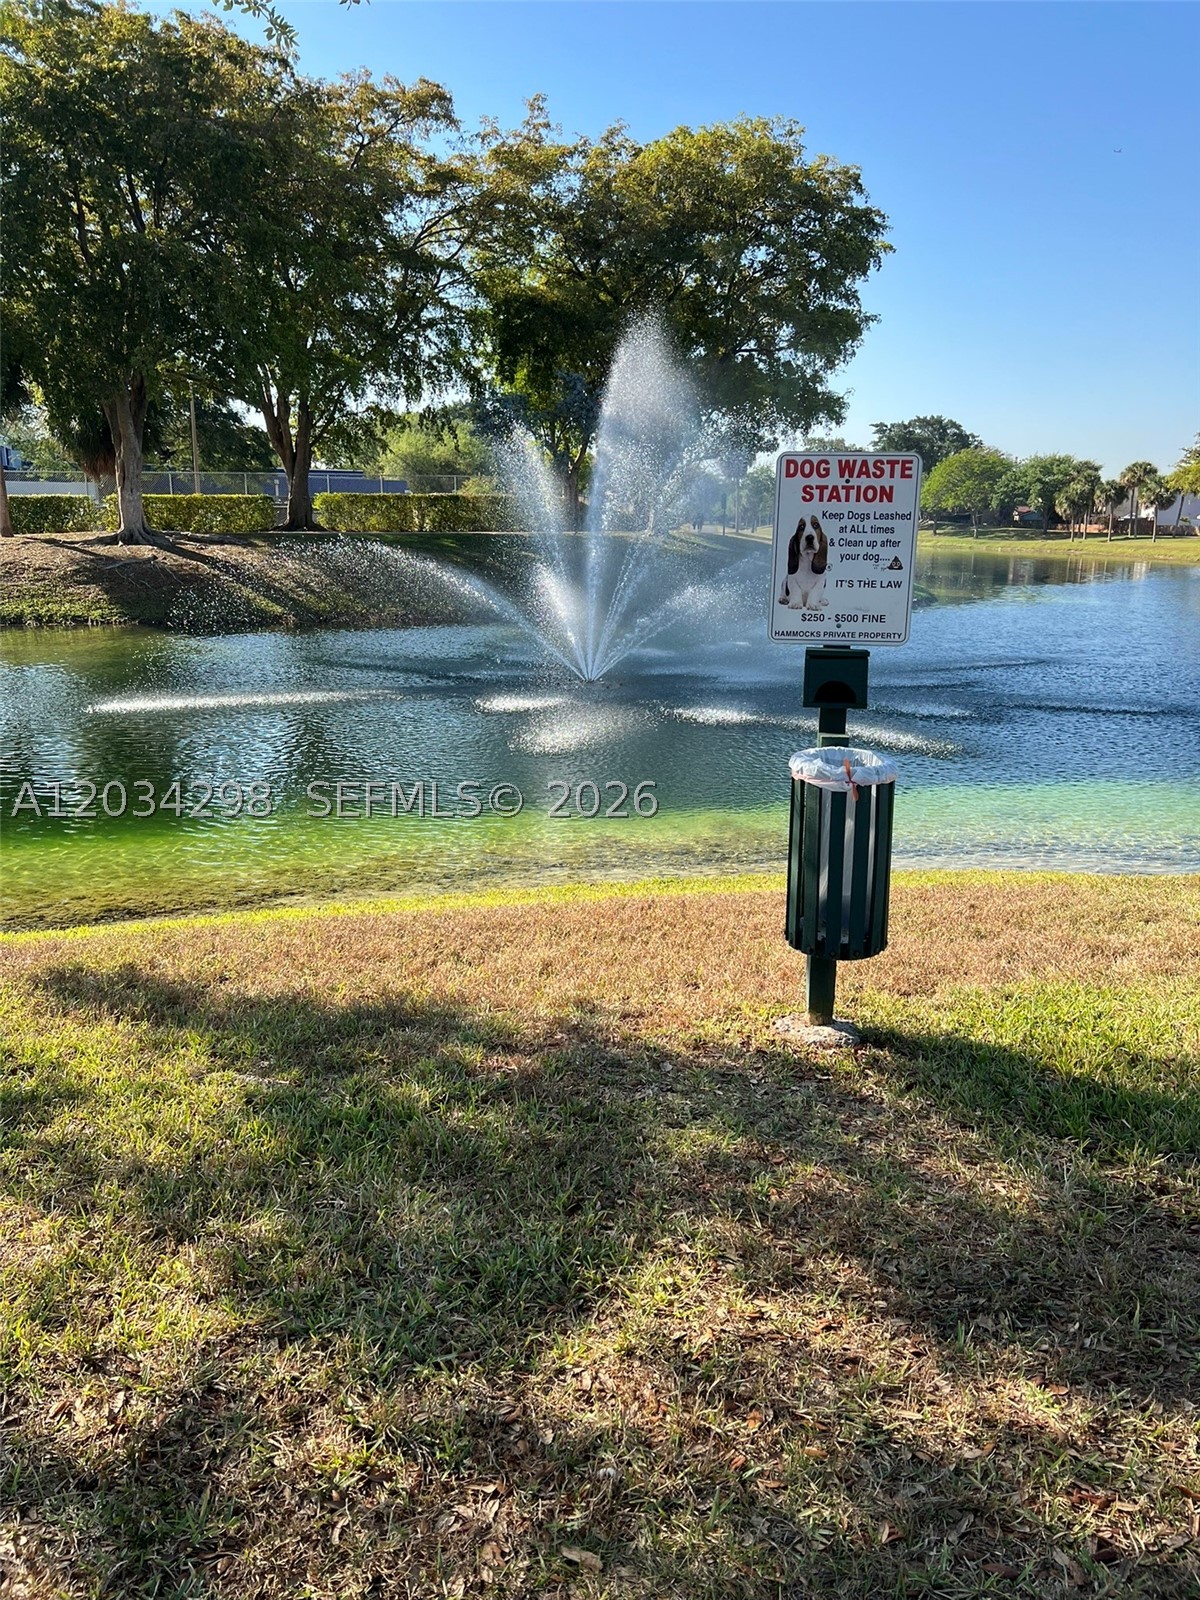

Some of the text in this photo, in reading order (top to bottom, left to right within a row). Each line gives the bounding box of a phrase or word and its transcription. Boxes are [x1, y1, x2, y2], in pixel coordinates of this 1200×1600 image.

[785, 459, 914, 479] DOG WASTE
[801, 484, 894, 503] STATION
[822, 510, 912, 522] Keep Dogs Leashed
[839, 525, 895, 534] at ALL times
[829, 538, 901, 549] & Clean up after
[839, 553, 860, 562] your
[835, 580, 902, 588] IT'S THE LAW
[801, 613, 825, 622] $250
[834, 614, 858, 623] $500
[862, 614, 886, 623] FINE
[774, 630, 821, 638] HAMMOCKS
